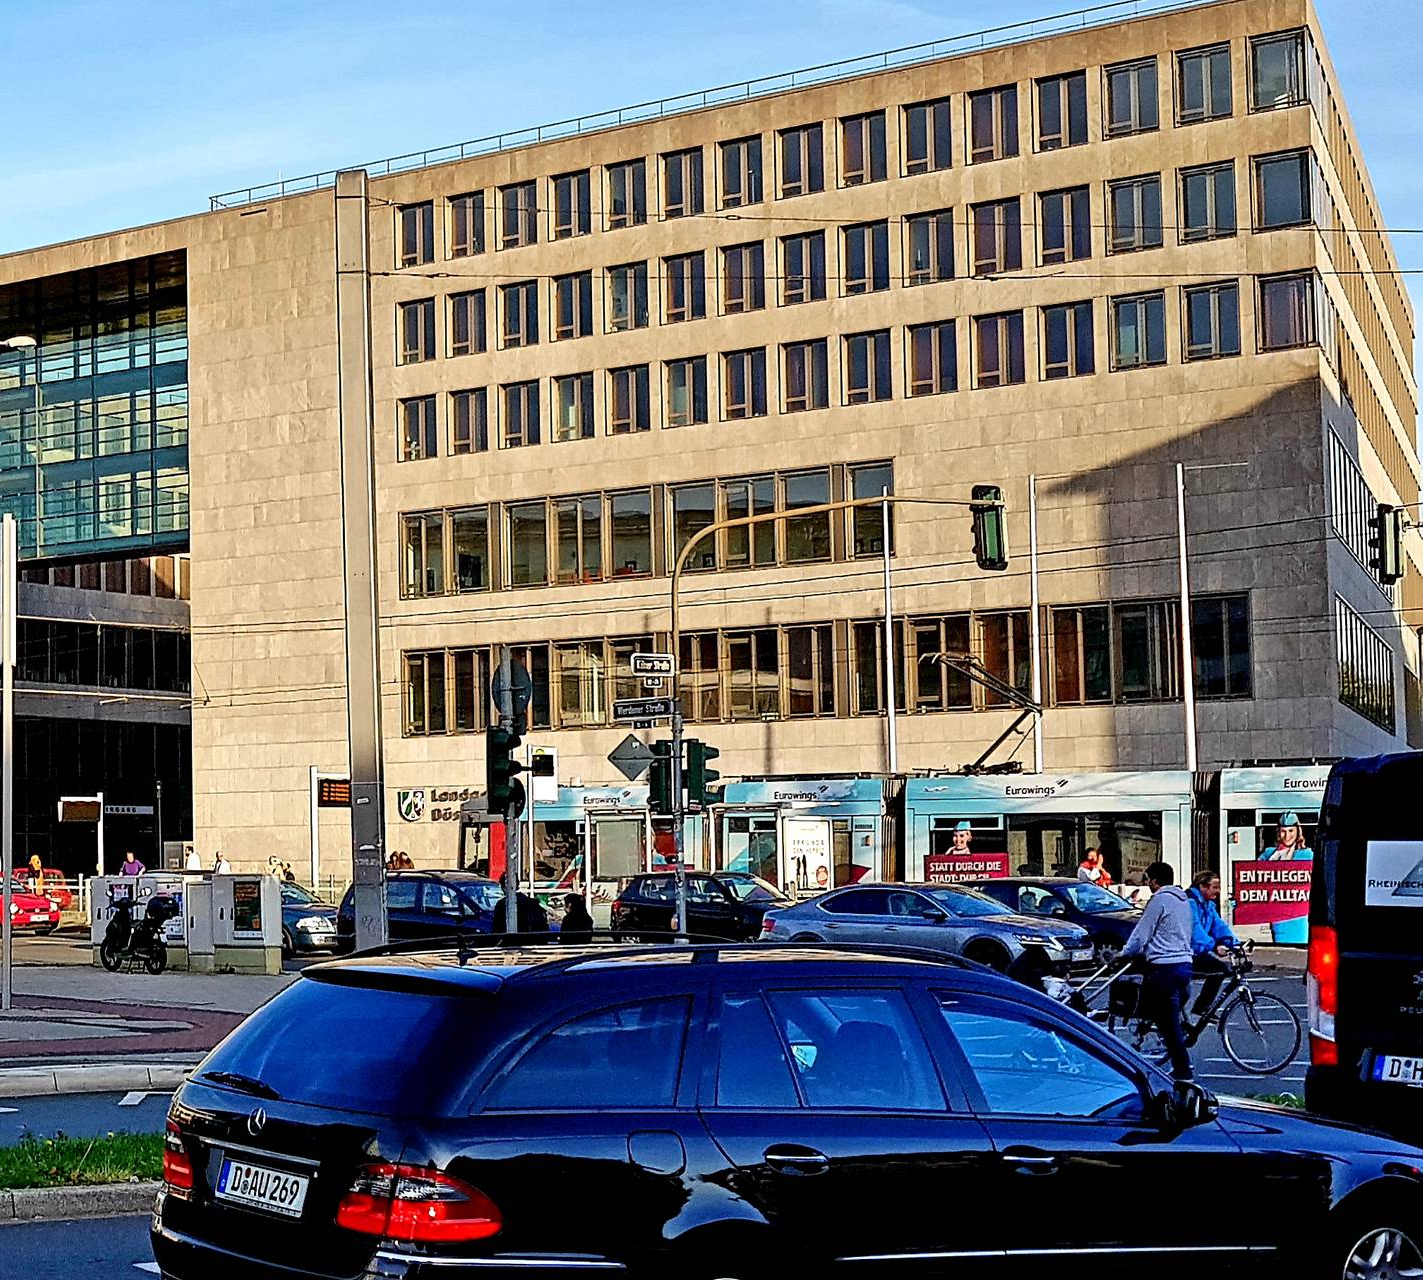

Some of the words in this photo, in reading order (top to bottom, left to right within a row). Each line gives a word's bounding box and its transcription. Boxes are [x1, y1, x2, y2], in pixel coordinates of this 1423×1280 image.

[774, 790, 818, 801] Eurowings
[1005, 785, 1055, 796] Eurowings
[583, 796, 621, 806] Eurowings
[929, 861, 955, 872] STATT
[956, 861, 985, 872] DURCH
[986, 861, 1002, 871] DIE
[1239, 870, 1312, 883] ENTFLIEGEN
[1239, 889, 1268, 902] DEM
[231, 1166, 242, 1191] D
[270, 1175, 299, 1205] 269
